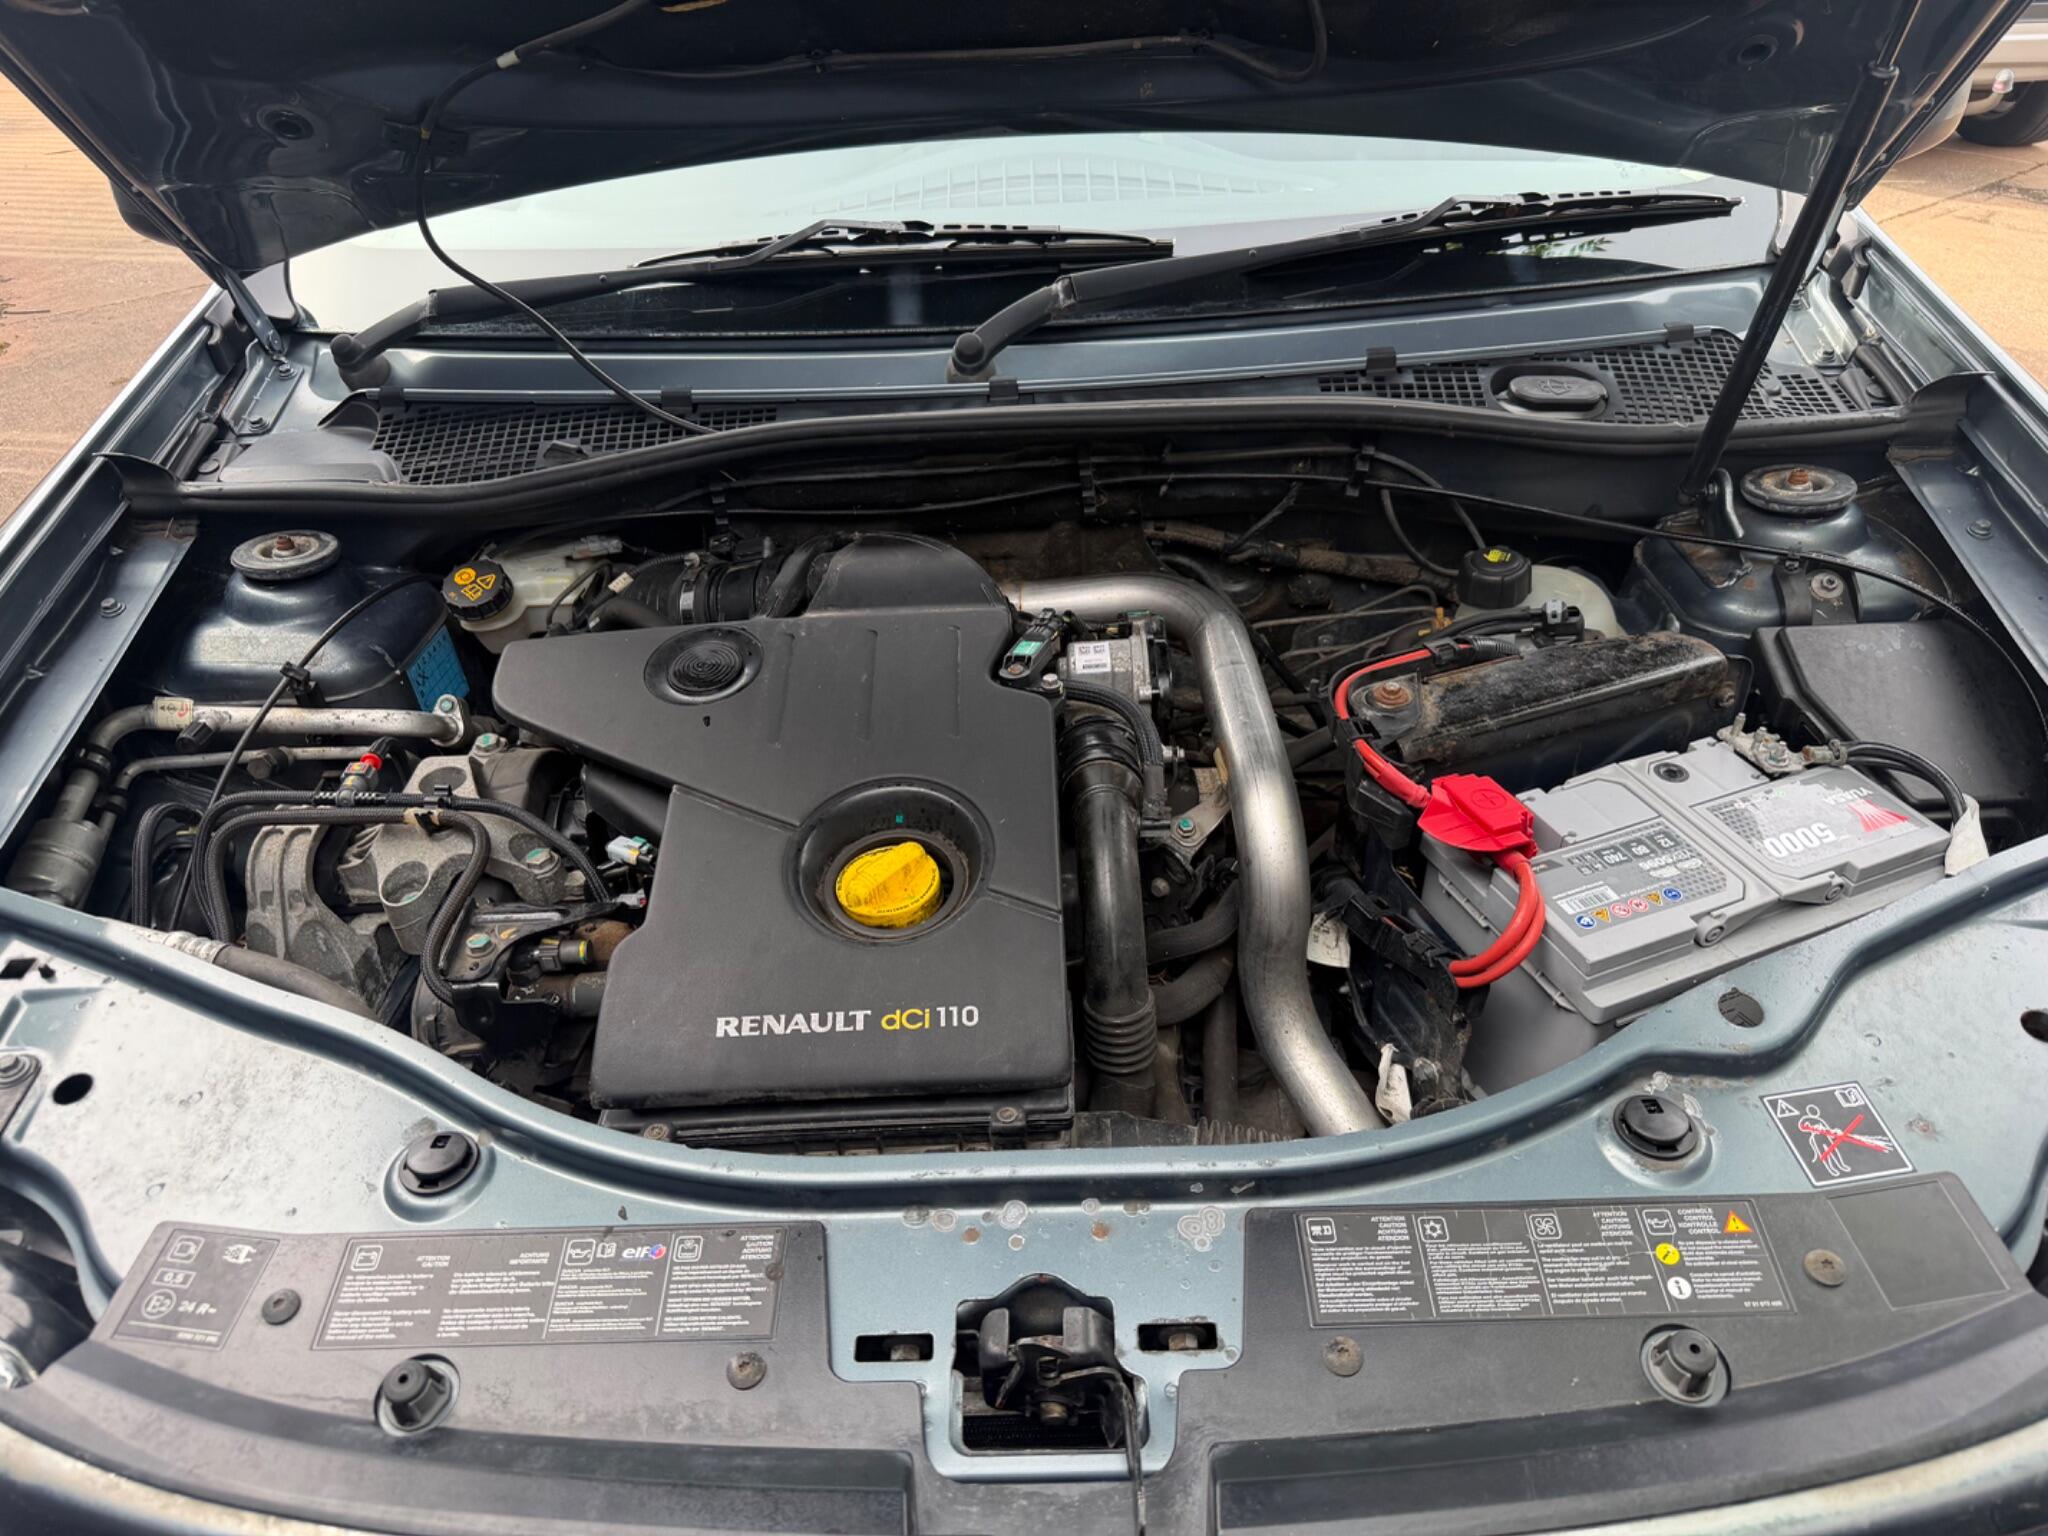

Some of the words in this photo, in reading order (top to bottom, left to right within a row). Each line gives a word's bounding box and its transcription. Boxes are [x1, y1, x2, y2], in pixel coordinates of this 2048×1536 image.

[1763, 821, 1837, 858] 5000
[715, 1010, 872, 1038] RENAULT
[880, 1008, 931, 1031] dCi
[936, 1005, 979, 1028] 110
[621, 1246, 651, 1259] elf
[146, 1295, 172, 1313] E2
